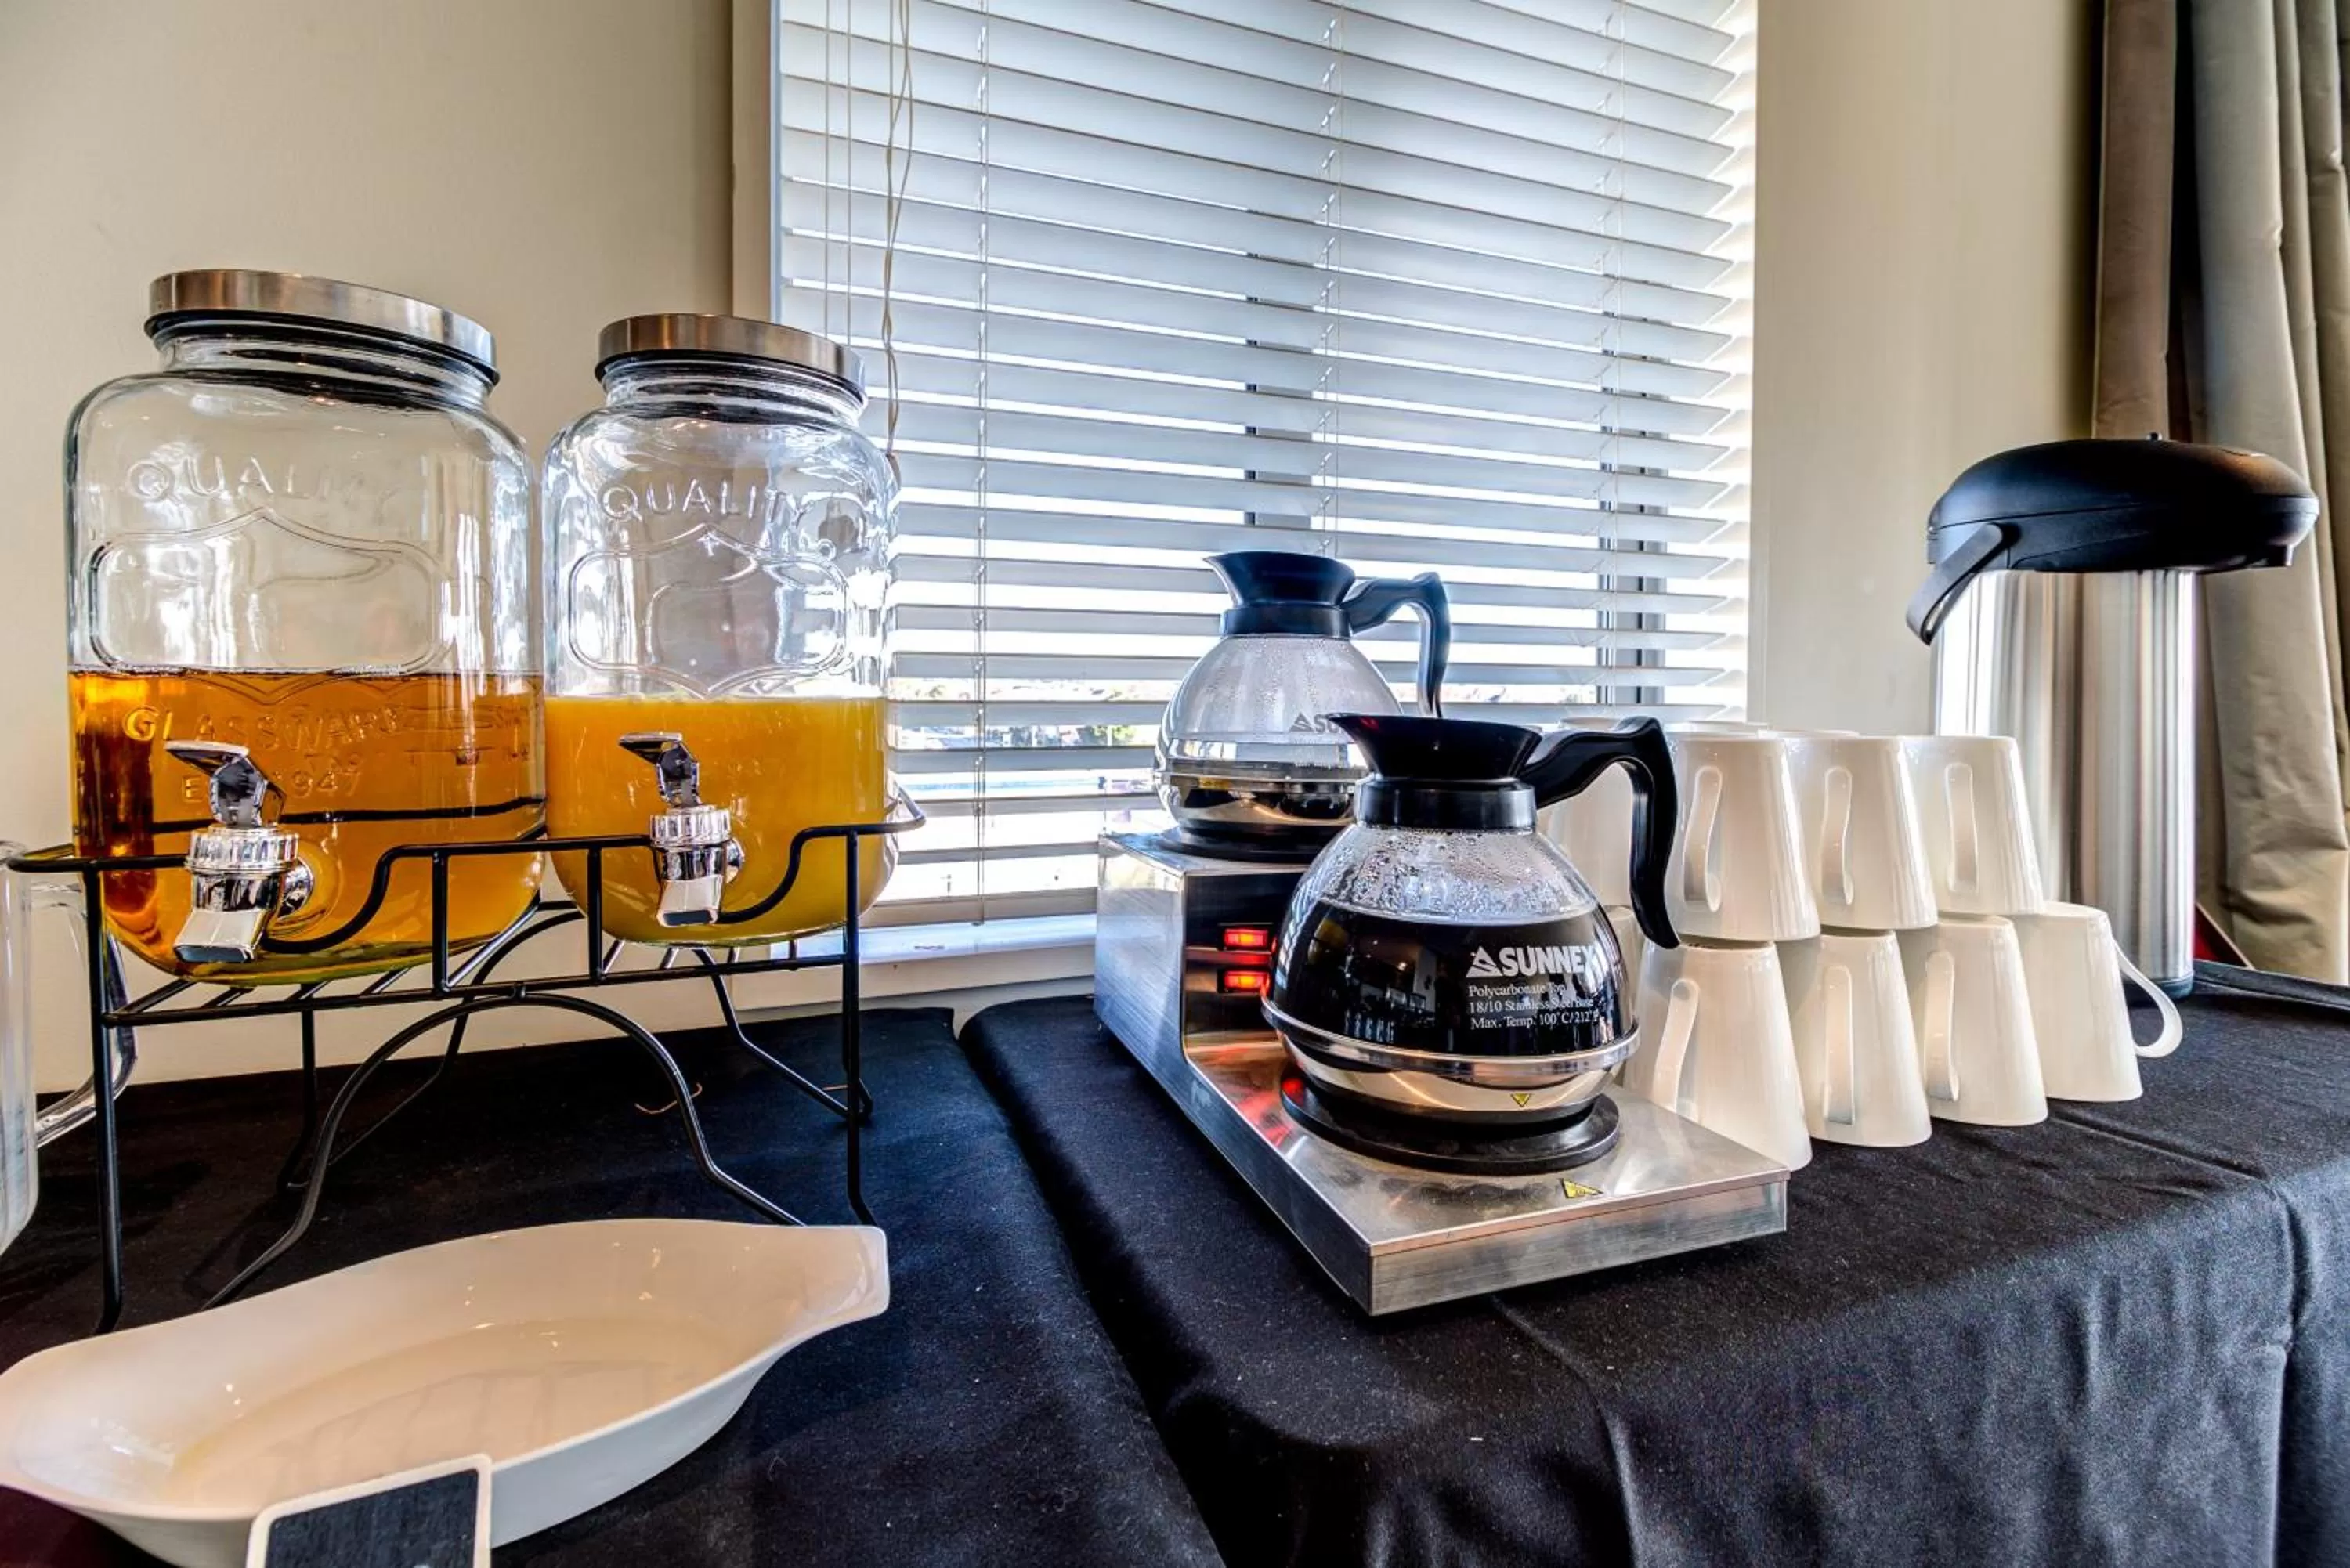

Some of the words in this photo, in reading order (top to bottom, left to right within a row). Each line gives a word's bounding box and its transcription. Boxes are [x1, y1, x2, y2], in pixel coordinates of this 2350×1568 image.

[1499, 945, 1599, 977] SUNNEX
[1468, 983, 1546, 1000] Polycarbonate
[1549, 983, 1566, 995] Top
[1469, 999, 1502, 1014] 18/10
[1505, 999, 1549, 1013] Stainless
[1470, 1017, 1502, 1031] Max.
[1506, 1014, 1537, 1030] Temp.
